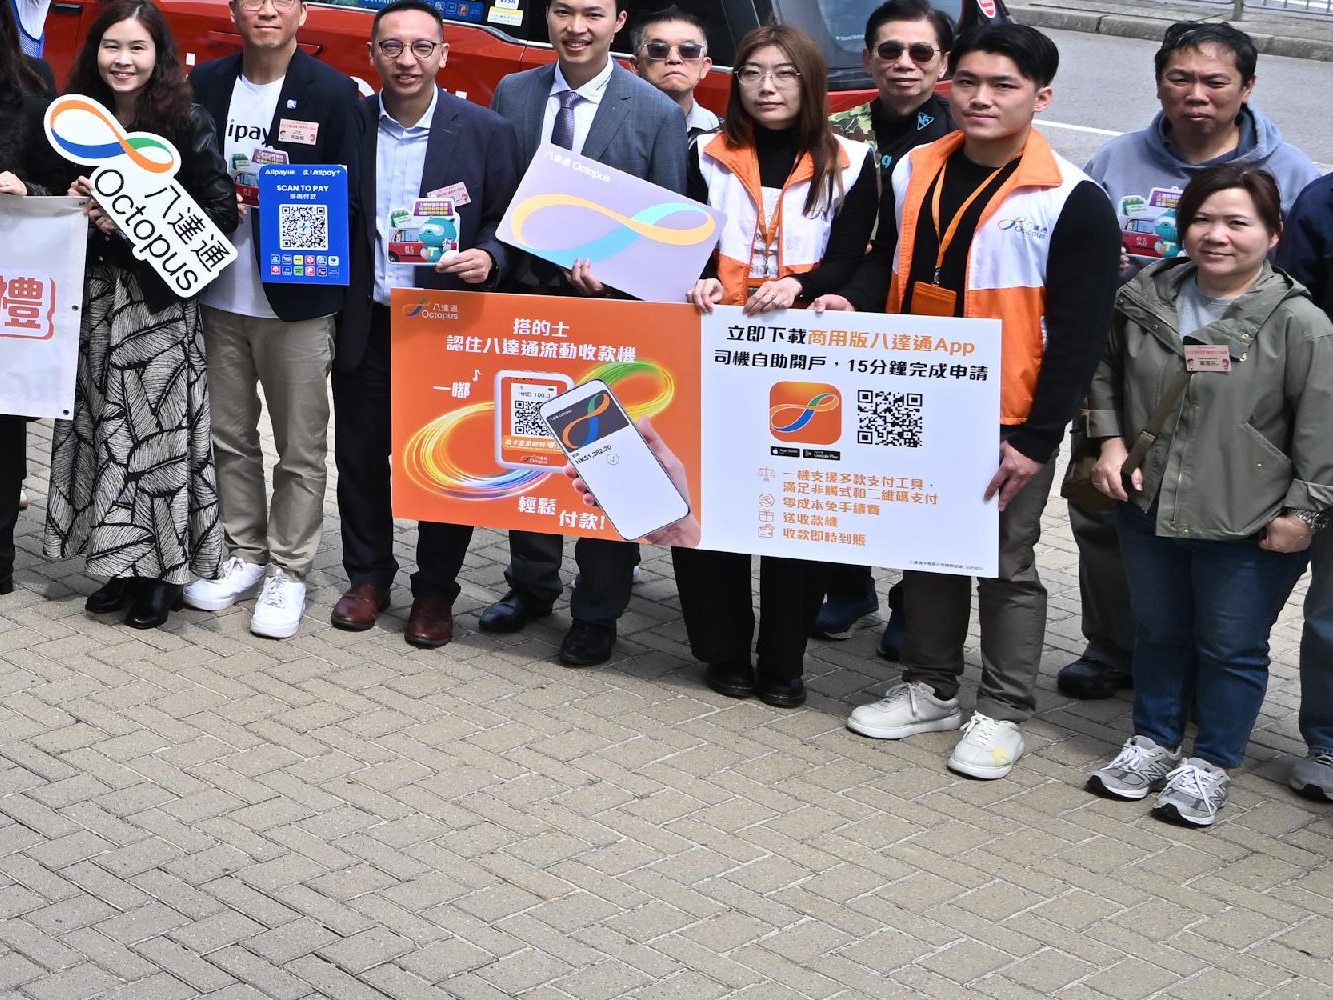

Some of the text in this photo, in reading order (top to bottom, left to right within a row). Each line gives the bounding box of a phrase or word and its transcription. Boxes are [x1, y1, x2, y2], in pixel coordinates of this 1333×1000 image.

[227, 119, 267, 144] ipay
[572, 161, 611, 184] Octopus
[276, 184, 300, 192] SCAN
[94, 168, 198, 291] Octopus
[144, 185, 230, 273] 八達通
[421, 308, 459, 320] Octopus
[513, 317, 570, 338] 搭的士
[445, 334, 637, 363] 認住八達通流動收款機
[726, 324, 976, 356] 立即下載商用版八達通App
[433, 382, 470, 399] 一嘟
[518, 496, 557, 515] 輕鬆
[782, 496, 880, 516] 零成本免手續費
[782, 511, 838, 528] 送收款機
